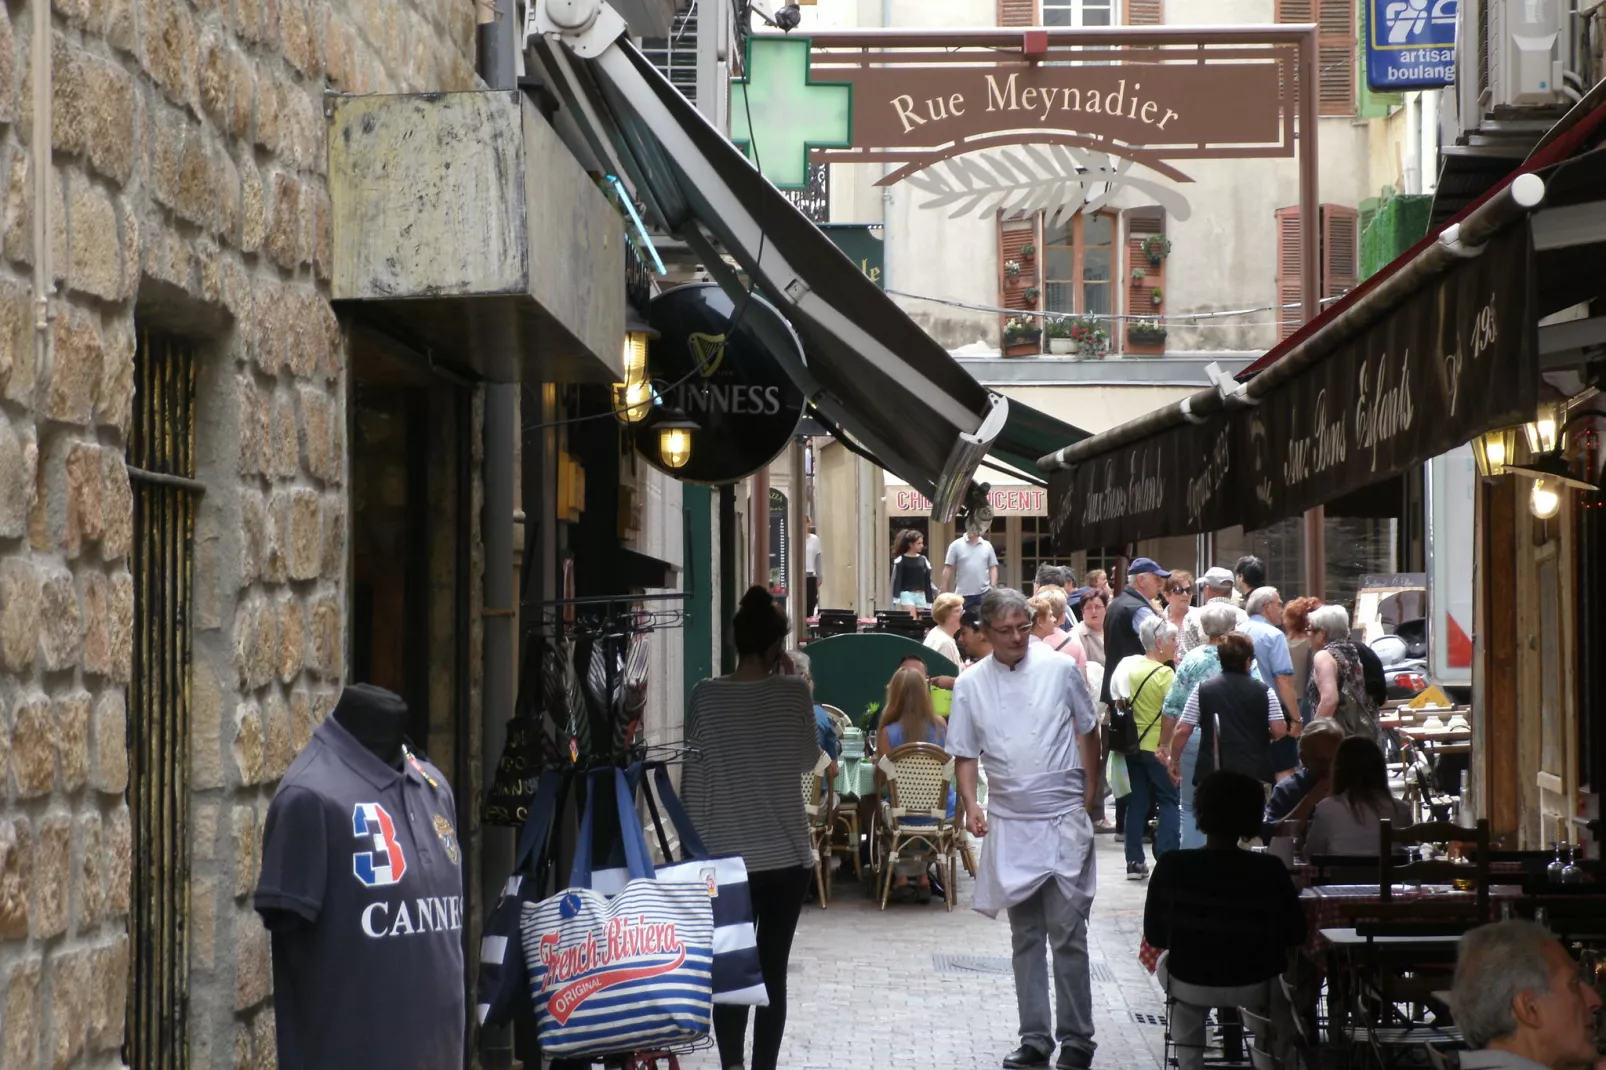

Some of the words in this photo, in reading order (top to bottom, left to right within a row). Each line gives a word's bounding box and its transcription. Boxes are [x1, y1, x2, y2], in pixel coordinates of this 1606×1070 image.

[889, 93, 966, 134] Rue
[984, 72, 1179, 131] Meynadier
[658, 382, 780, 416] INNESS
[1356, 348, 1414, 473] Enfants
[896, 490, 934, 511] CHE
[986, 490, 1044, 511] CENT
[352, 802, 407, 888] 3
[361, 896, 463, 938] CANNE
[539, 929, 600, 994] French
[601, 914, 680, 966] Riviera
[555, 977, 602, 1013] ORIGINAL
